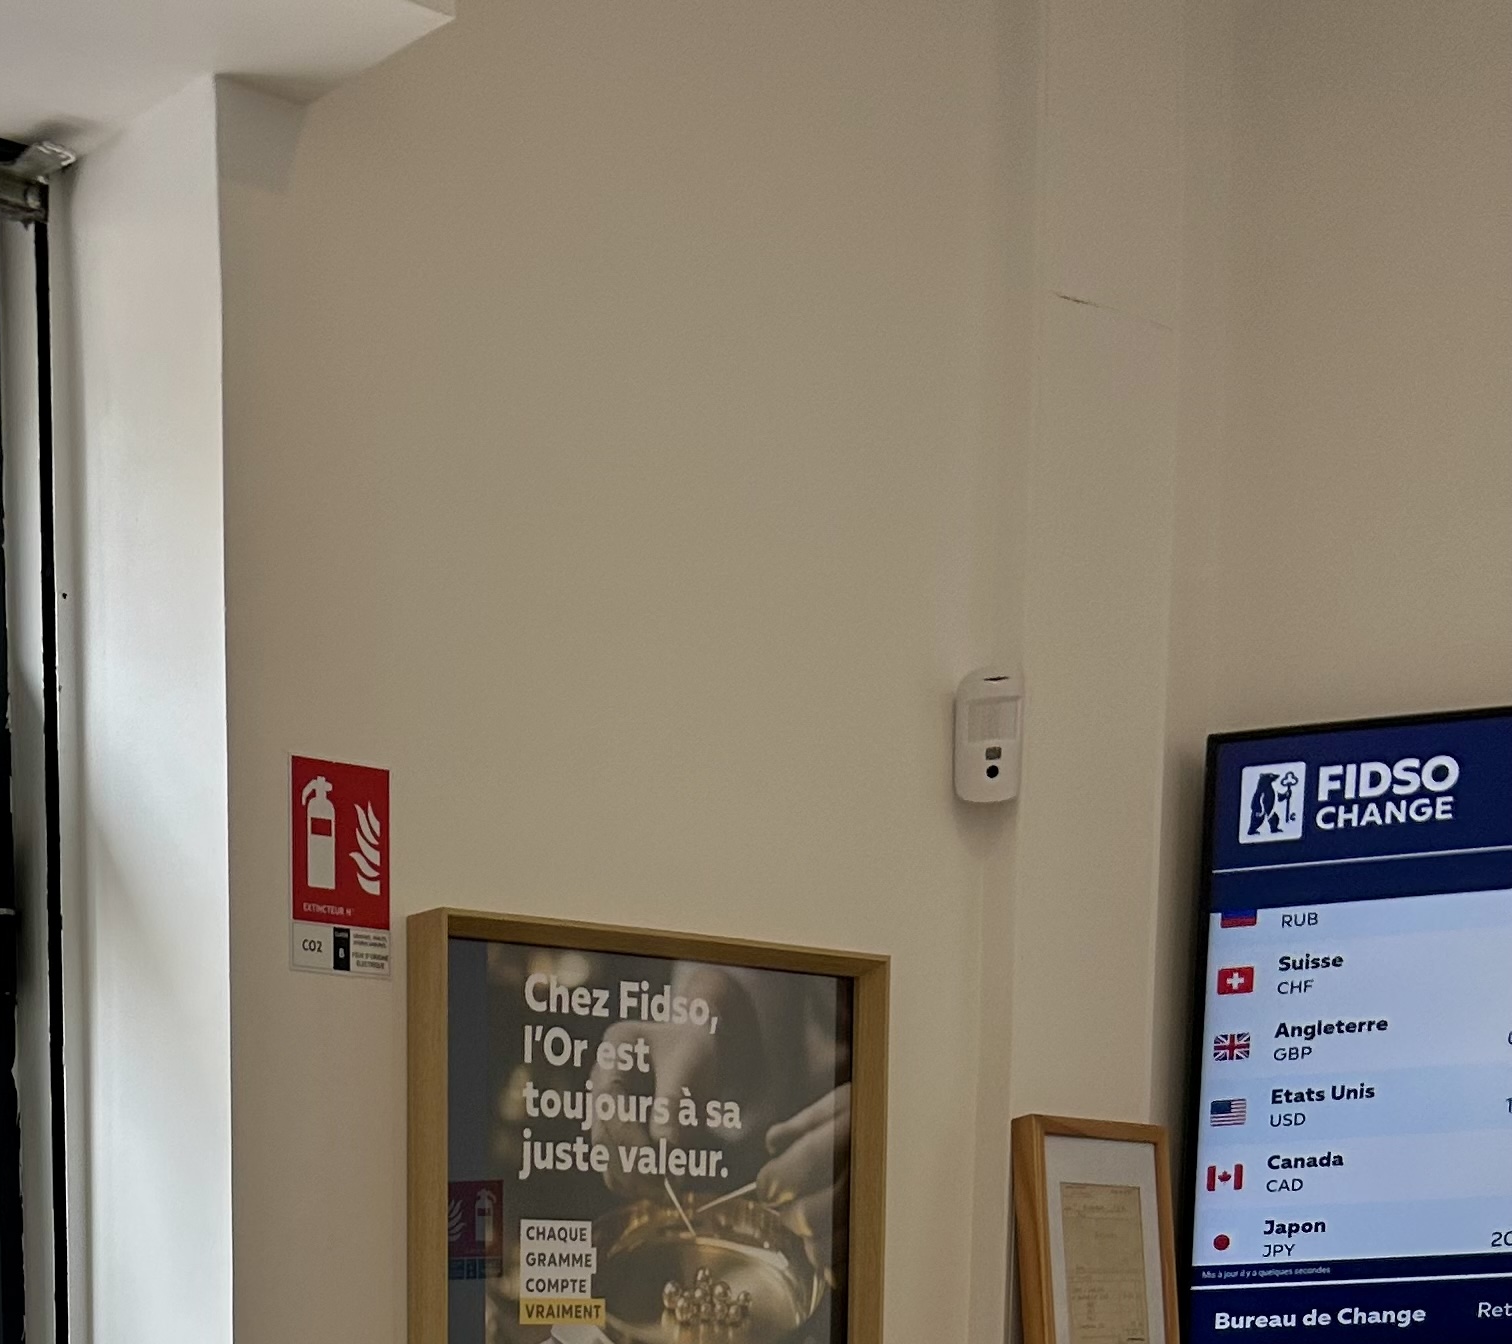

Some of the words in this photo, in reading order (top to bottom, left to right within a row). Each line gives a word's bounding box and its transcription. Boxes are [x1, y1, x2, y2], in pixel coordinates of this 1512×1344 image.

[1317, 755, 1460, 801] FIDSO
[1316, 797, 1455, 831] CHANGE
[303, 902, 345, 916] EXTINCTEUR
[1281, 912, 1319, 929] RUB
[302, 938, 323, 953] CO2
[1278, 952, 1344, 973] Suisse
[1277, 979, 1314, 995] CHF
[525, 972, 610, 1018] Chez
[619, 979, 719, 1034] Fidso,
[1274, 1017, 1389, 1040] Angleterre
[523, 1024, 588, 1067] l'Or
[596, 1037, 650, 1073] est
[1273, 1046, 1313, 1063] GBP
[1271, 1085, 1326, 1105] Etats
[1331, 1083, 1375, 1102] Unis
[522, 1080, 670, 1130] toujours
[678, 1087, 698, 1127] à
[706, 1098, 742, 1130] sa
[1269, 1112, 1306, 1128] USD
[519, 1128, 610, 1180] juste
[618, 1137, 729, 1178] valeur.
[1267, 1151, 1344, 1170] Canada
[1266, 1178, 1304, 1194] CAD
[526, 1225, 588, 1244] CHAQUE
[1263, 1217, 1327, 1241] Japon
[525, 1251, 593, 1268] GRAMME
[1262, 1243, 1296, 1259] JPY
[525, 1277, 587, 1294] COMPTE
[525, 1303, 602, 1320] VRAIMENT
[1214, 1311, 1296, 1330] Bureau
[1302, 1308, 1331, 1326] de
[1337, 1307, 1426, 1328] Change
